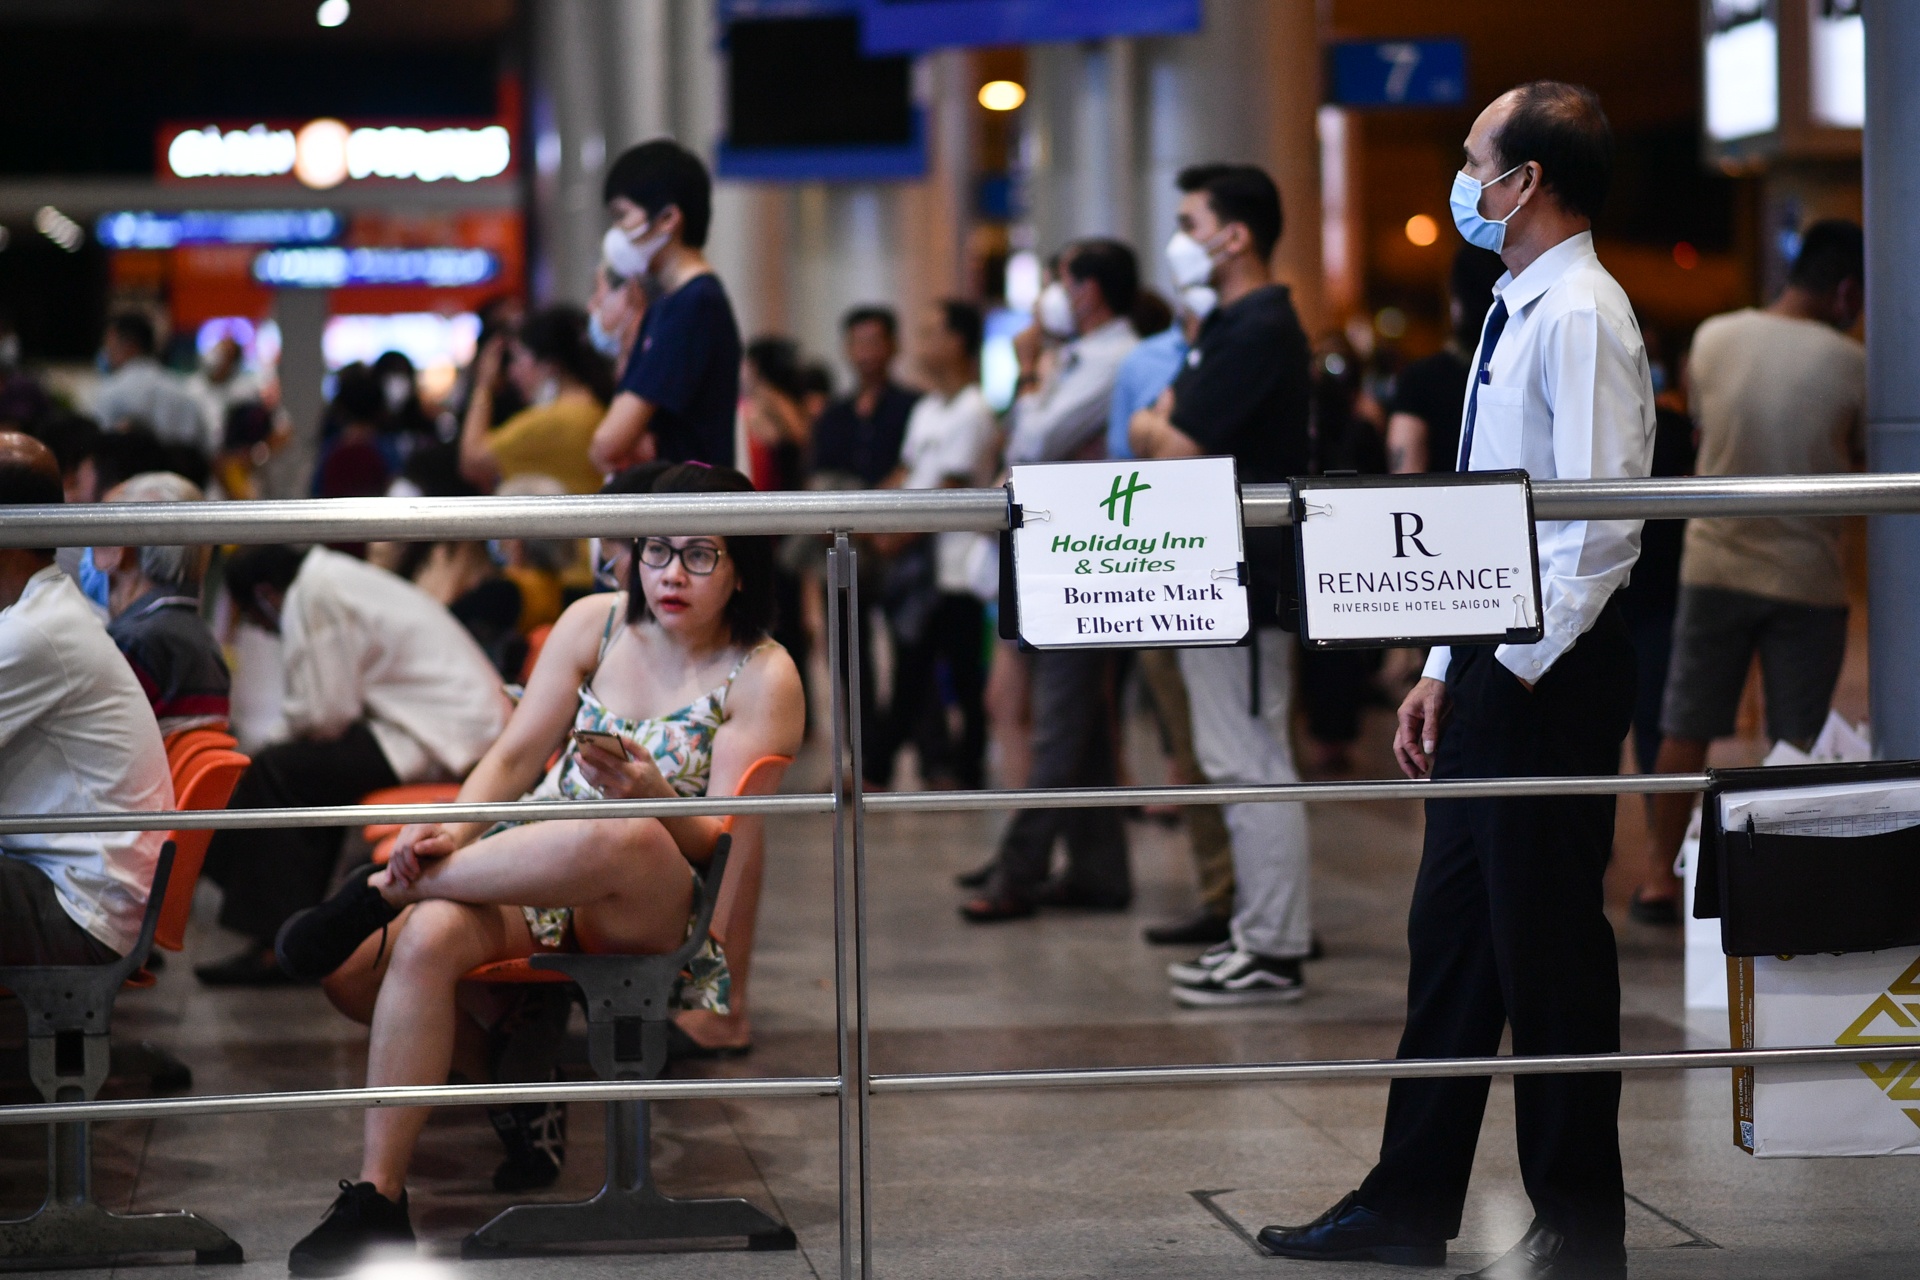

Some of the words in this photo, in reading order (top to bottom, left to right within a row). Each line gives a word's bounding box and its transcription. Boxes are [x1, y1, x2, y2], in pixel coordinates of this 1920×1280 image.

[1379, 44, 1419, 101] 7
[1051, 533, 1157, 554] Holiday
[1161, 531, 1206, 549] Inn
[1389, 512, 1442, 558] R
[1074, 559, 1093, 575] &
[1098, 557, 1176, 574] Suites
[1064, 586, 1156, 605] Bormate
[1163, 584, 1224, 602] Mark
[1333, 602, 1400, 613] RIVERSIDE
[1405, 600, 1446, 611] HOTEL
[1452, 599, 1500, 610] SAIGON
[1076, 616, 1144, 635] Elbert
[1150, 614, 1216, 632] White
